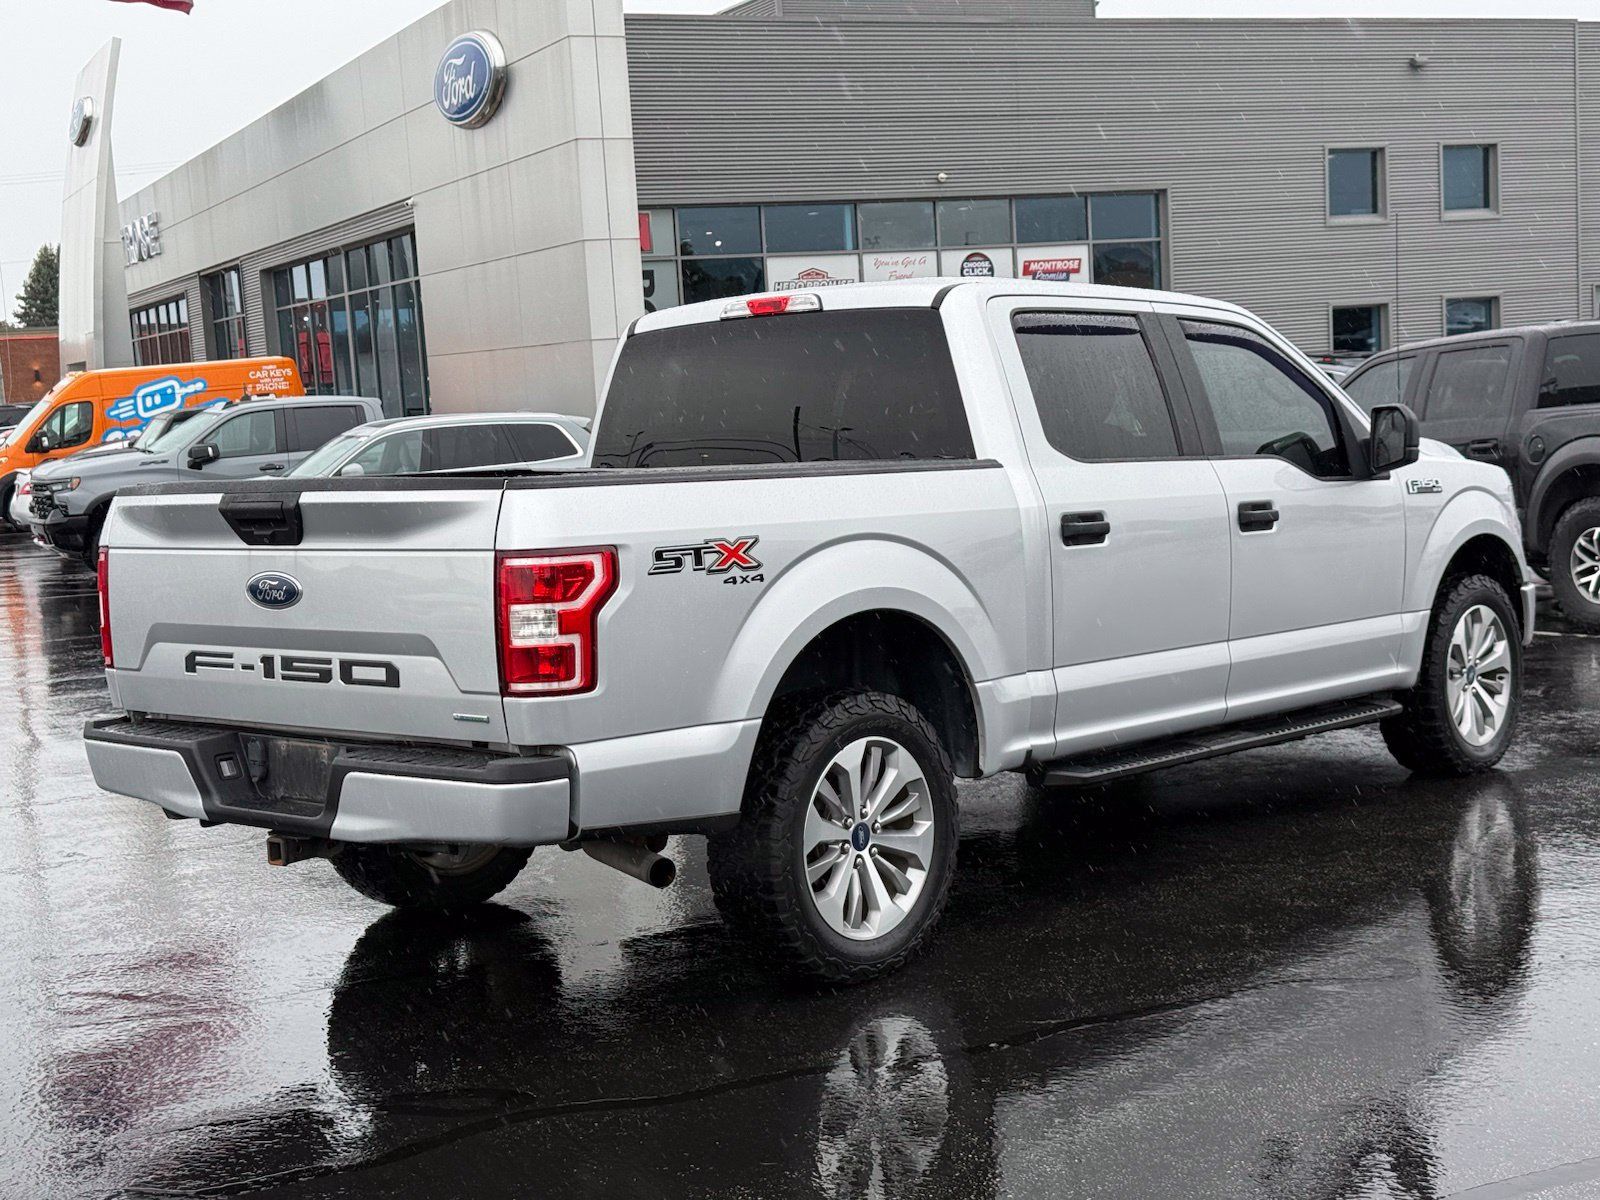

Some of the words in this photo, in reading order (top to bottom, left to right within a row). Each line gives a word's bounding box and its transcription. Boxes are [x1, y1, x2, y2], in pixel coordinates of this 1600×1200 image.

[442, 54, 477, 109] Ford
[1029, 260, 1080, 271] MONTROSE
[249, 371, 269, 379] CAR
[269, 368, 293, 377] KEYS
[256, 381, 290, 392] PHONE!
[648, 535, 763, 575] STX
[256, 579, 287, 601] Ford
[184, 650, 401, 688] F-150
